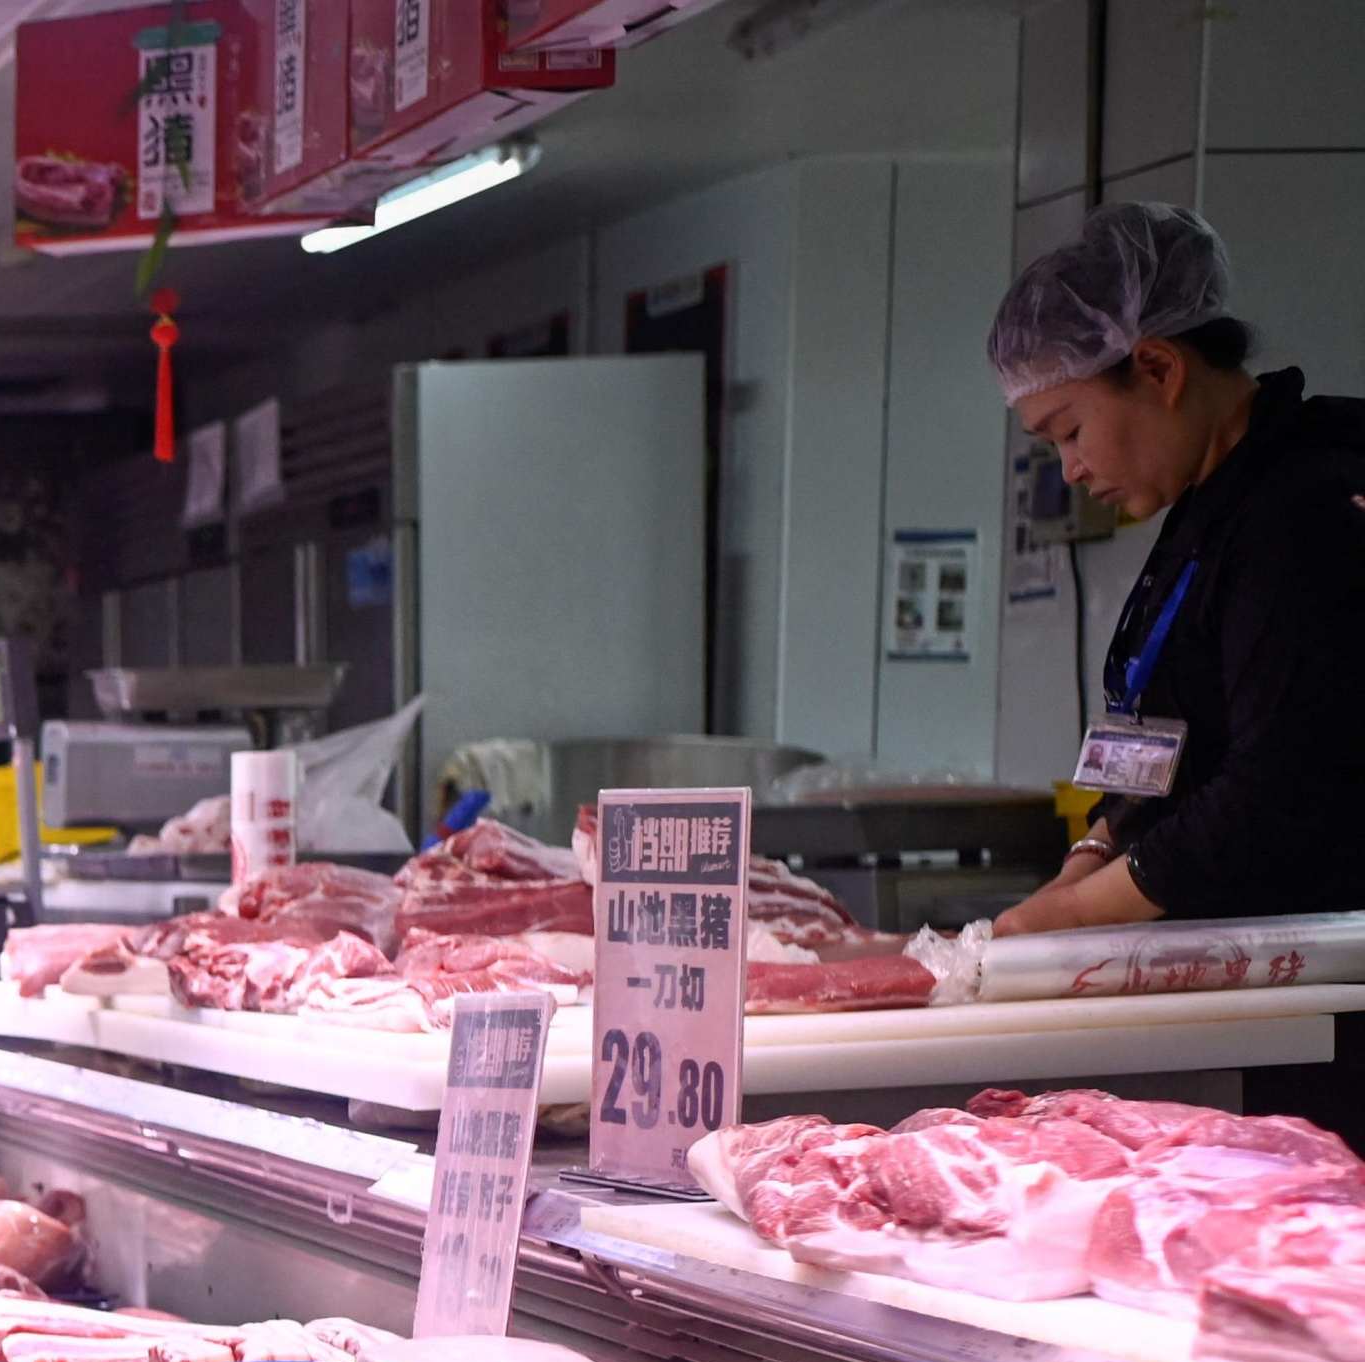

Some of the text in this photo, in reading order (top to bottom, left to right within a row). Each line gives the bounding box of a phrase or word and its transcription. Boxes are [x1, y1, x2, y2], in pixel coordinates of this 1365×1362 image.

[627, 816, 733, 873] 档期推荐
[607, 890, 733, 950] 山地黑猪
[626, 963, 706, 1012] 一刀切
[599, 1028, 725, 1131] 29.80
